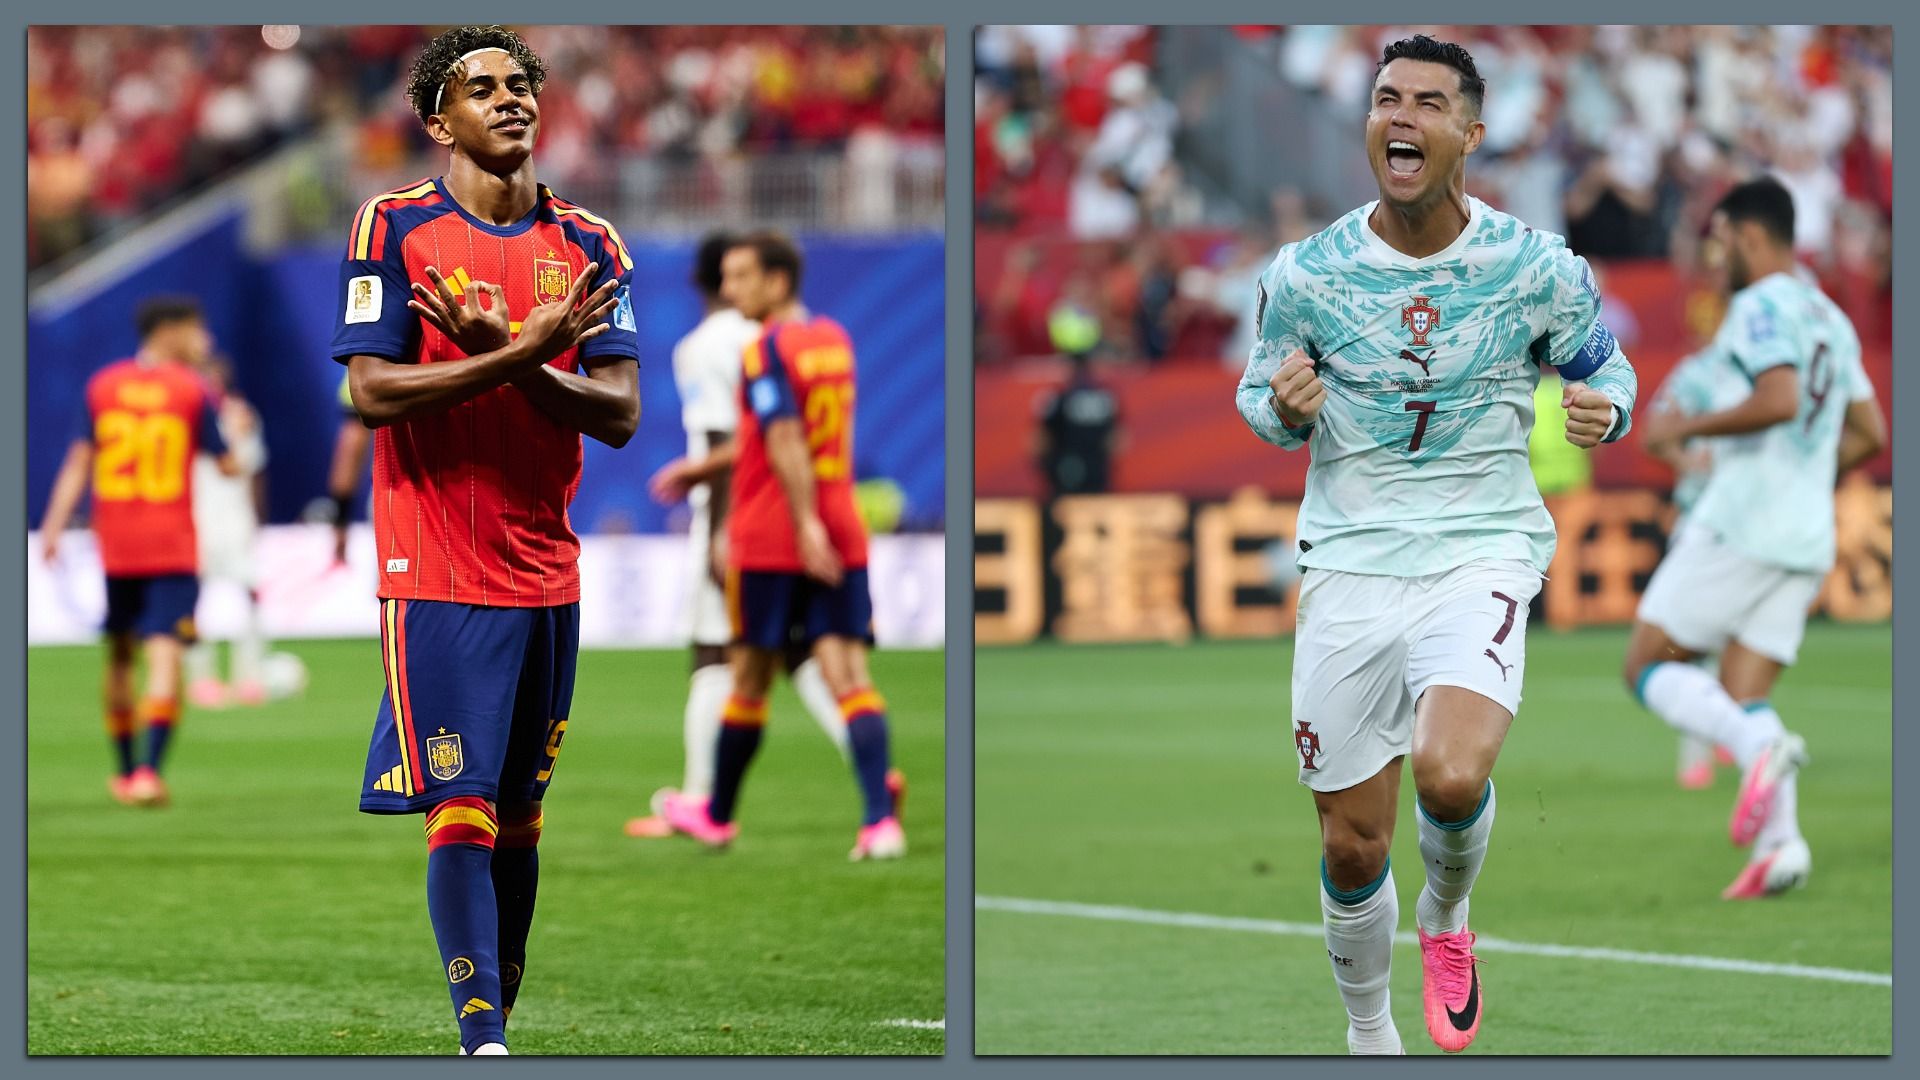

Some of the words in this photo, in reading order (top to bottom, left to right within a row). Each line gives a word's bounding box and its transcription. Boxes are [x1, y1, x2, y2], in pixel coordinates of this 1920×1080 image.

[1803, 342, 1833, 434] 9
[97, 410, 188, 502] 20
[1405, 399, 1437, 452] 7
[1491, 590, 1518, 646] 7
